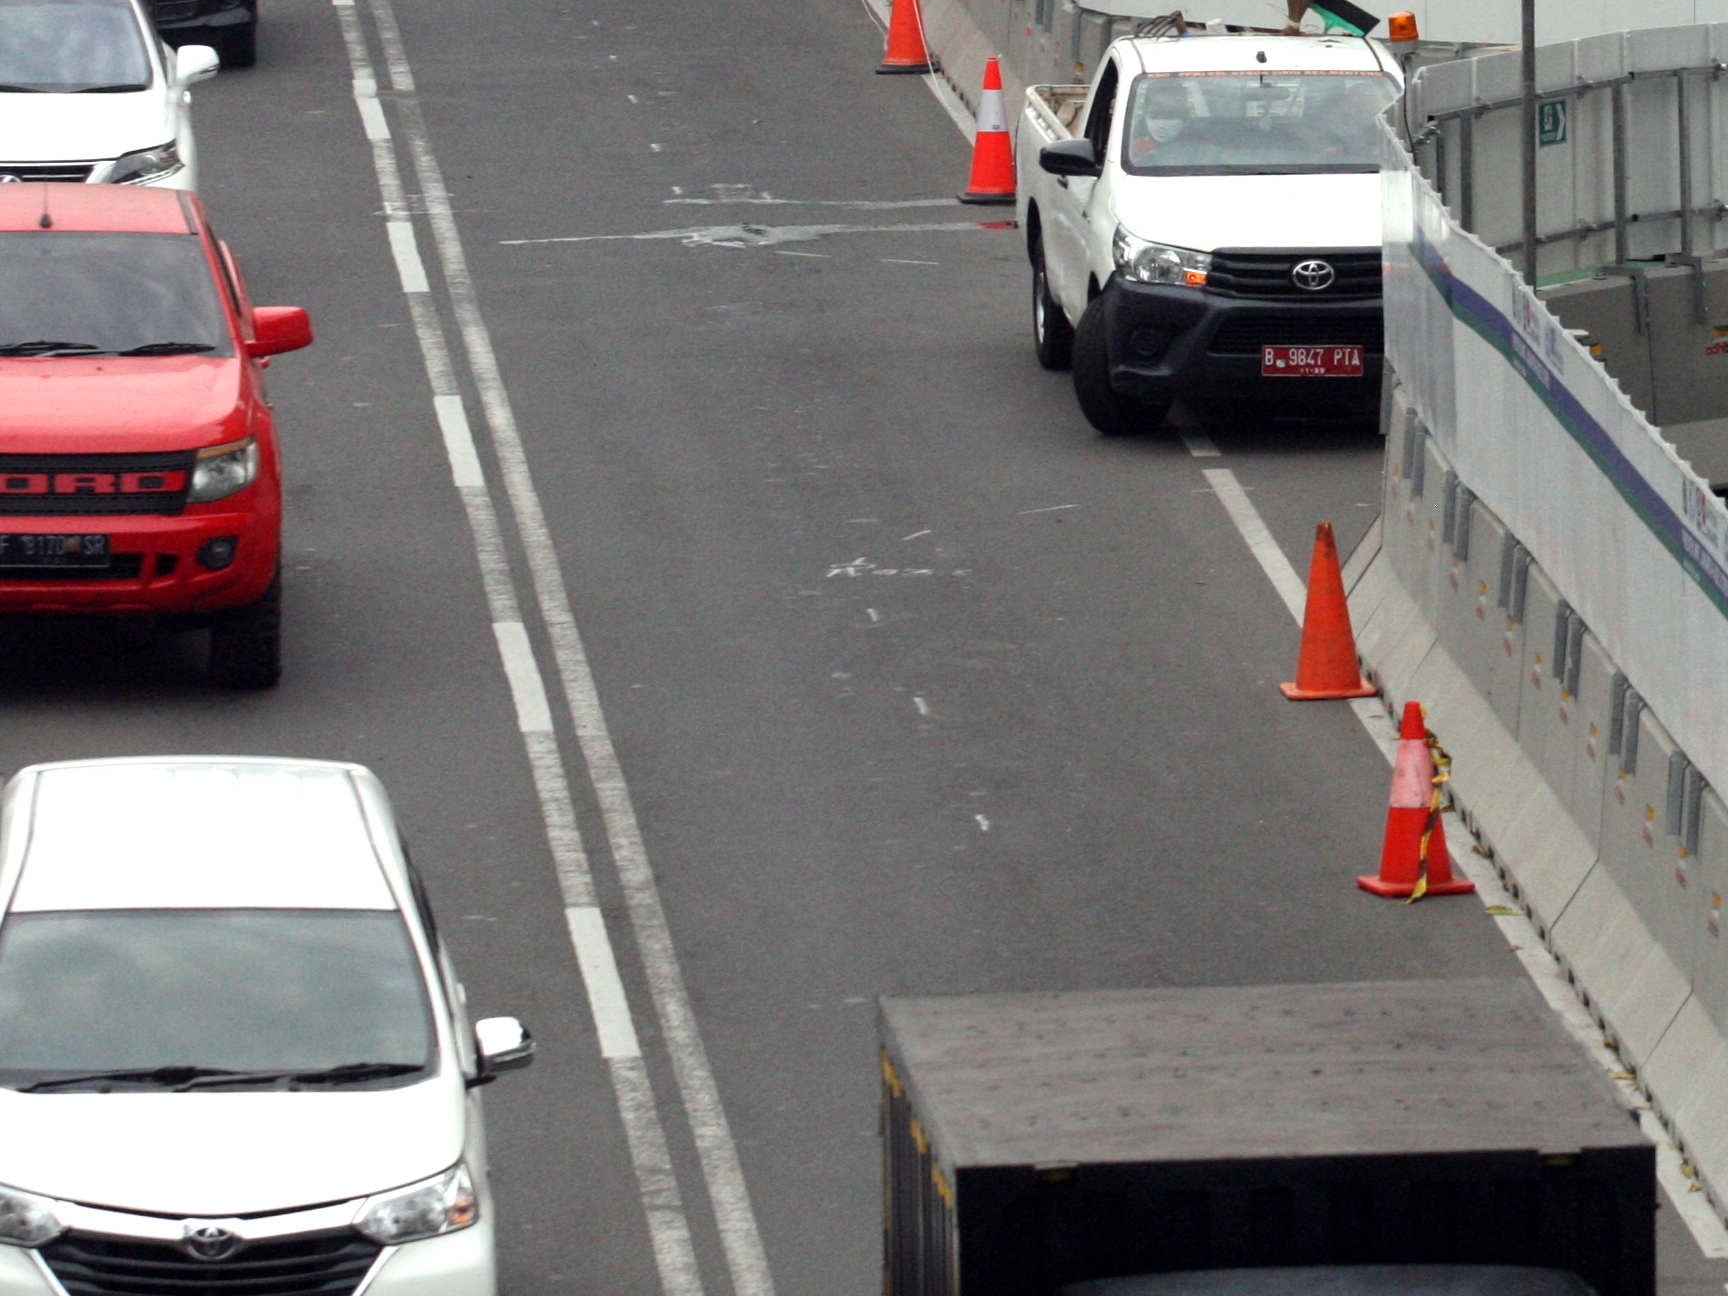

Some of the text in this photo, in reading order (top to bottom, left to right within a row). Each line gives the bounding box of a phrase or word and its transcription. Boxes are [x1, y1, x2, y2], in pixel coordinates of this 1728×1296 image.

[1265, 348, 1360, 366] B 9847 PTA
